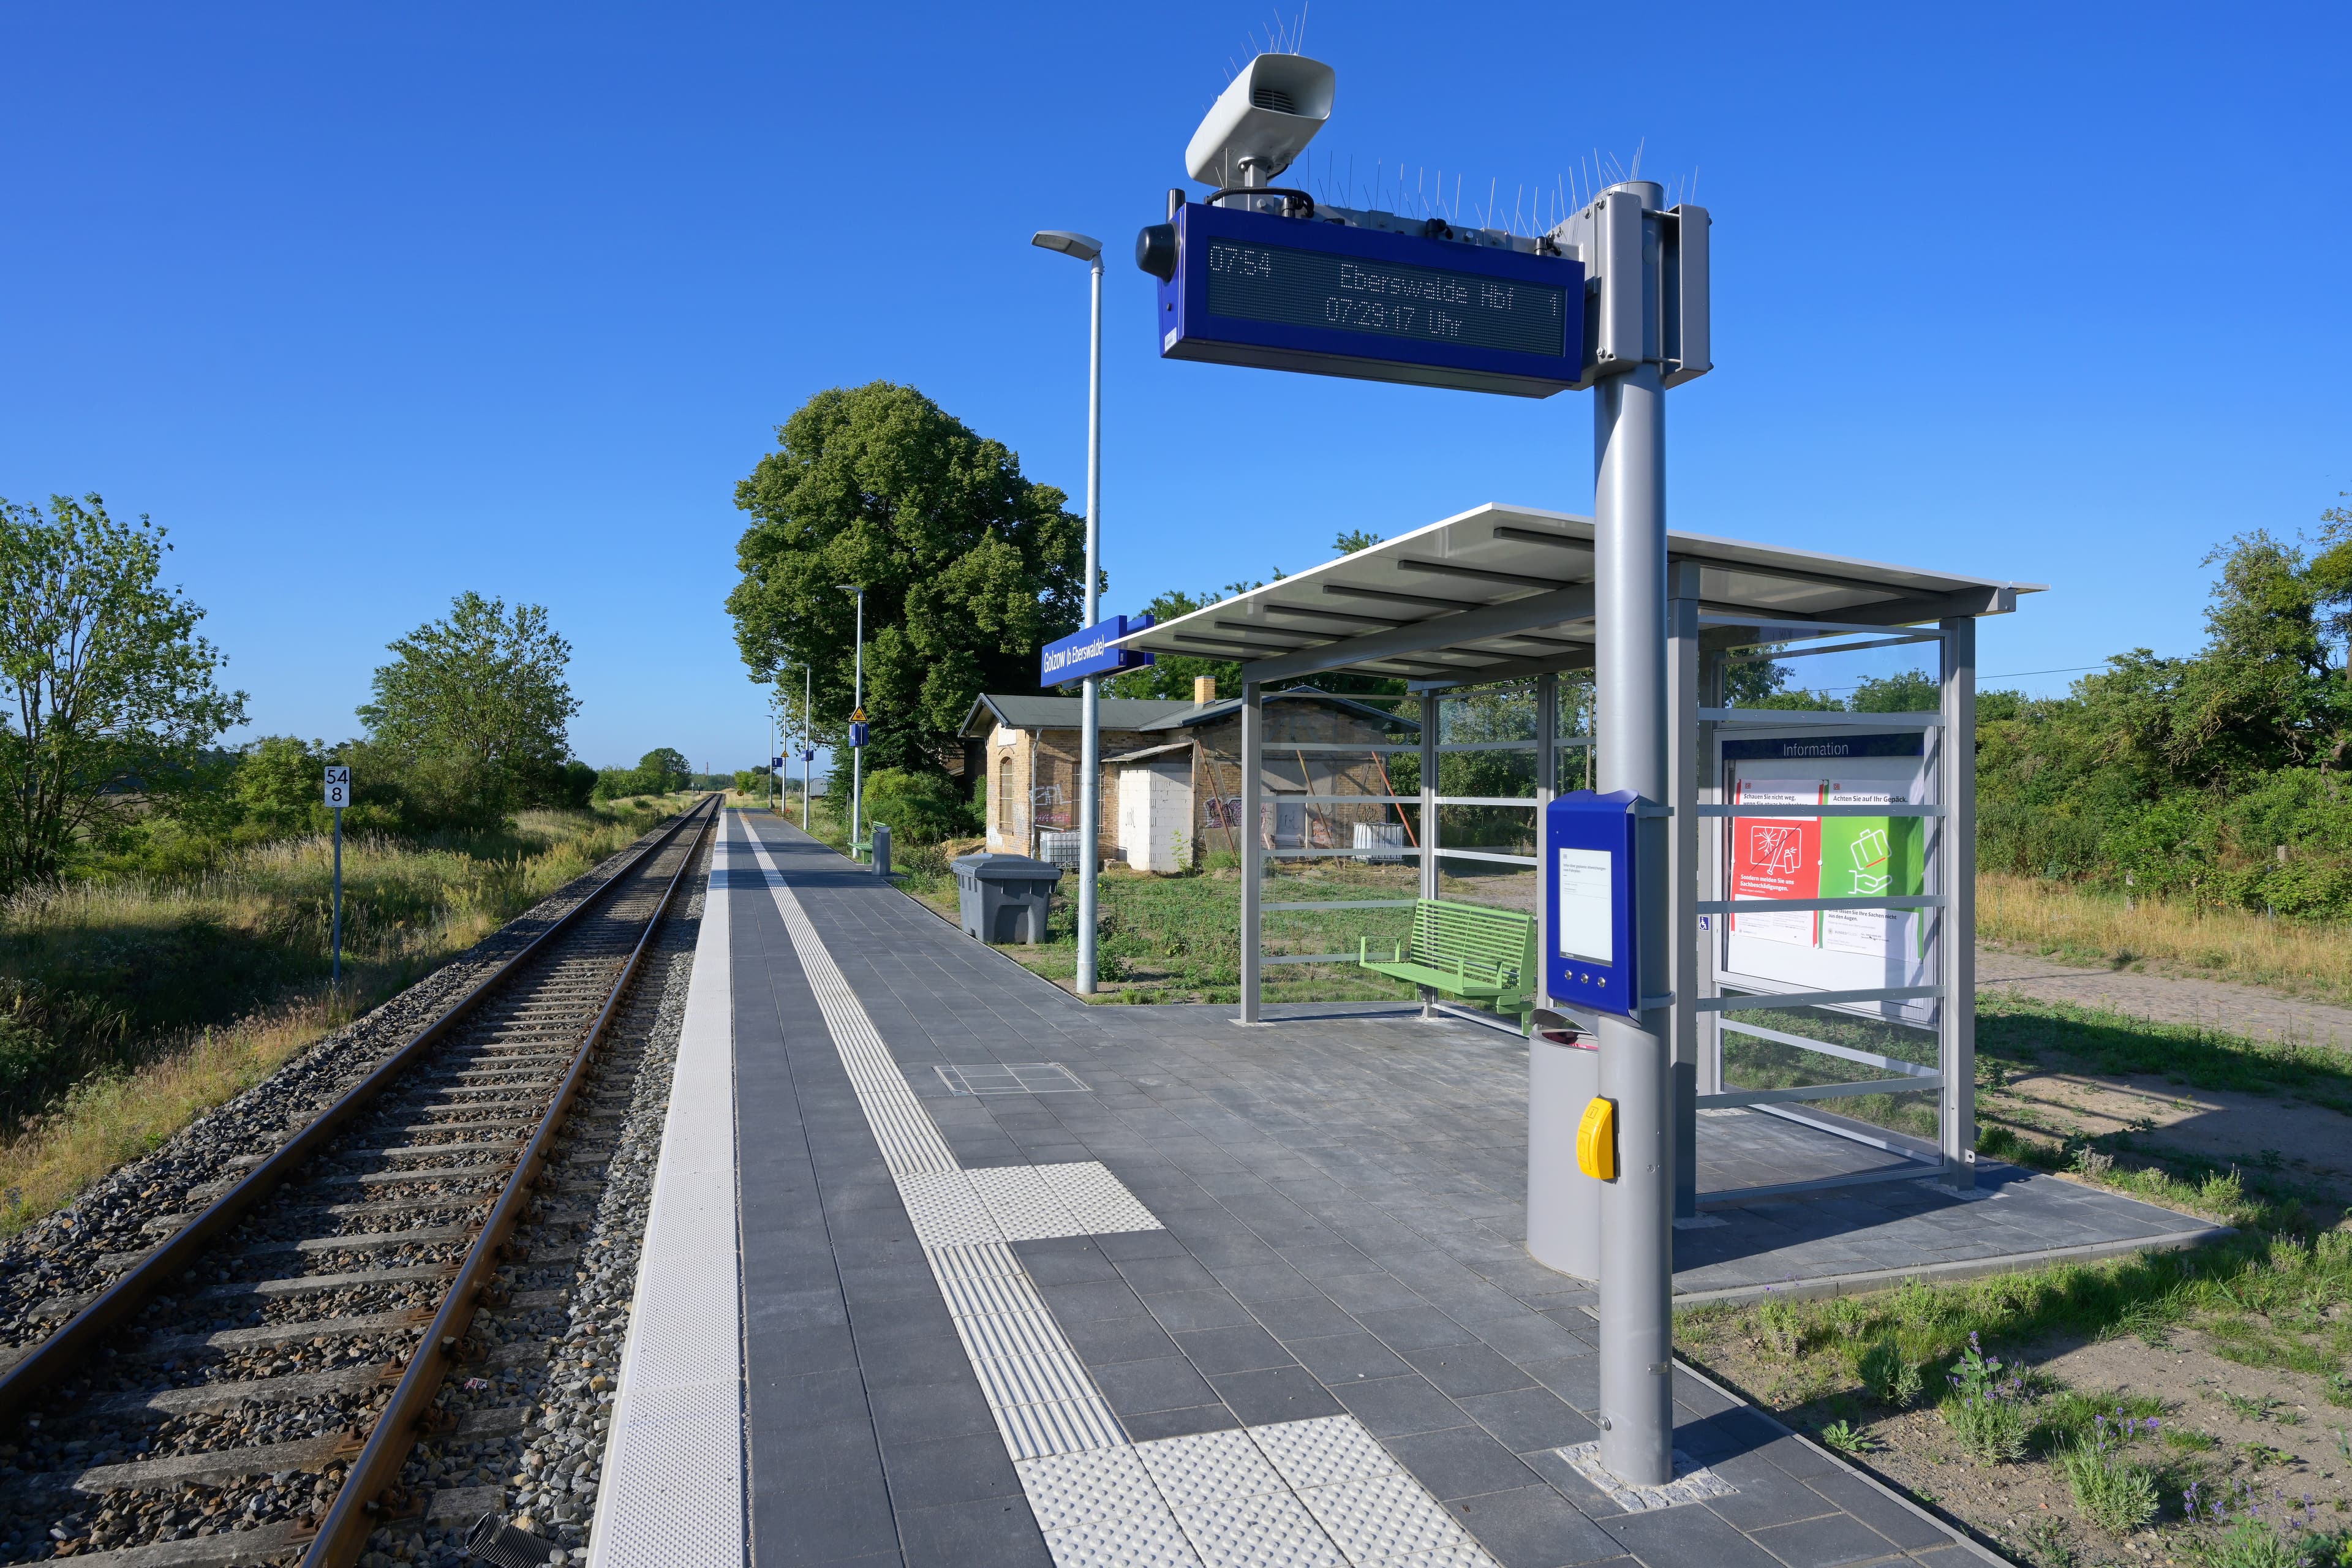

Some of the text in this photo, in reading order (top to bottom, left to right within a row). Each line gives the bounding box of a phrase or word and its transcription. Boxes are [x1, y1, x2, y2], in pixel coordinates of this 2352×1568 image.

[1210, 246, 1557, 316] 07:54 Eberswalde Hbf 1
[1326, 296, 1463, 336] 07:29:17 Uhr
[1044, 634, 1104, 673] Golzow (b Eberswalde)
[1784, 742, 1849, 756] Information
[326, 769, 348, 784] 54
[331, 787, 342, 802] 8
[1740, 881, 1789, 892] Sachbeschädigungen.
